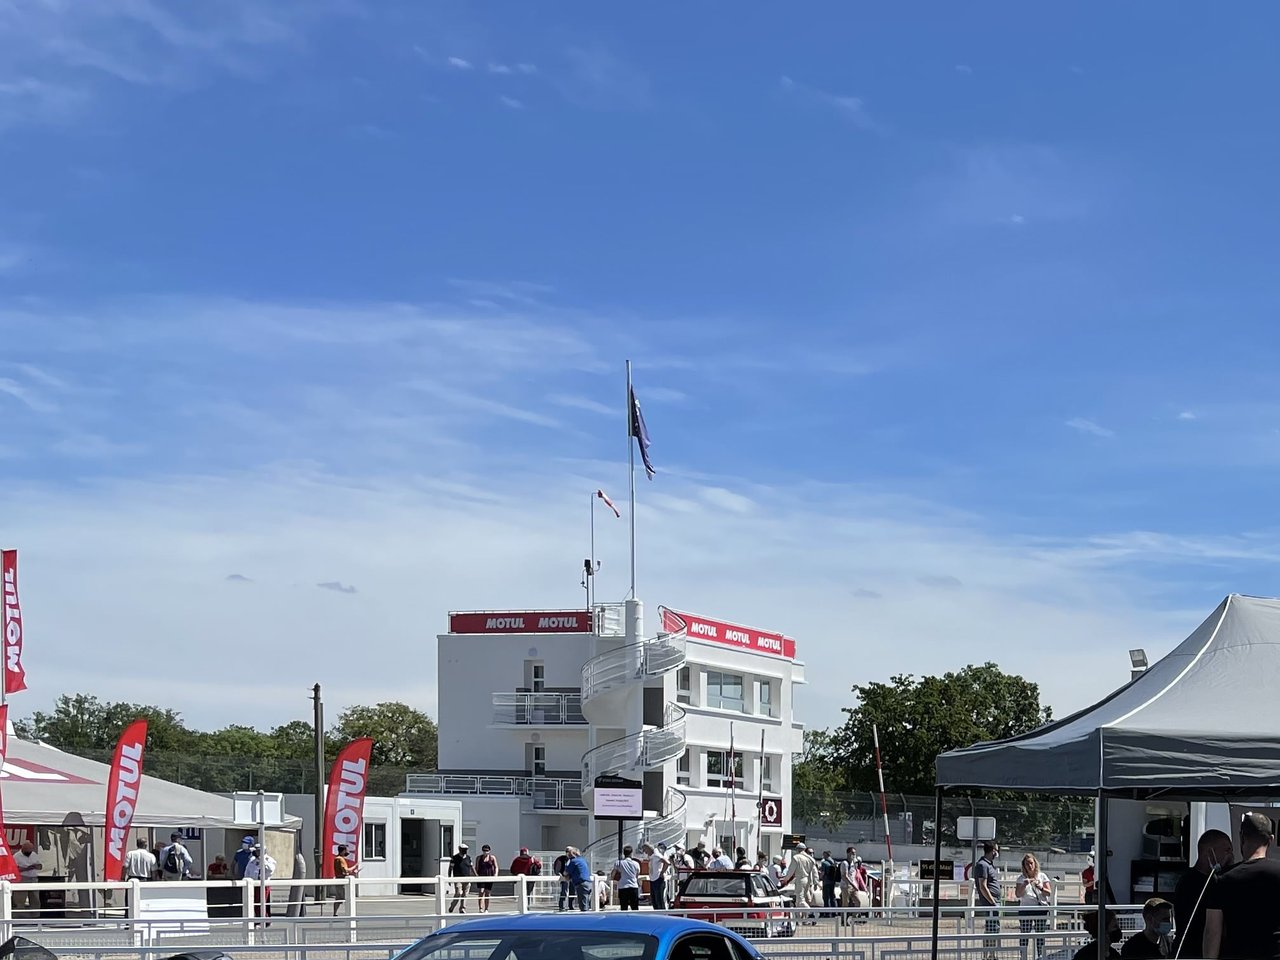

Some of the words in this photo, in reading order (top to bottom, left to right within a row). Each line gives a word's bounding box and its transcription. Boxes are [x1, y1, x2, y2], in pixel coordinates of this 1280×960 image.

[5, 568, 20, 672] MOTUL
[486, 618, 525, 629] MOTUL
[538, 617, 578, 628] MOTUL
[691, 622, 717, 637] MOTUL
[725, 629, 750, 644] MOTUL
[757, 637, 781, 650] MOTUL
[109, 742, 142, 861] MOTUL
[332, 757, 366, 862] MOTUL
